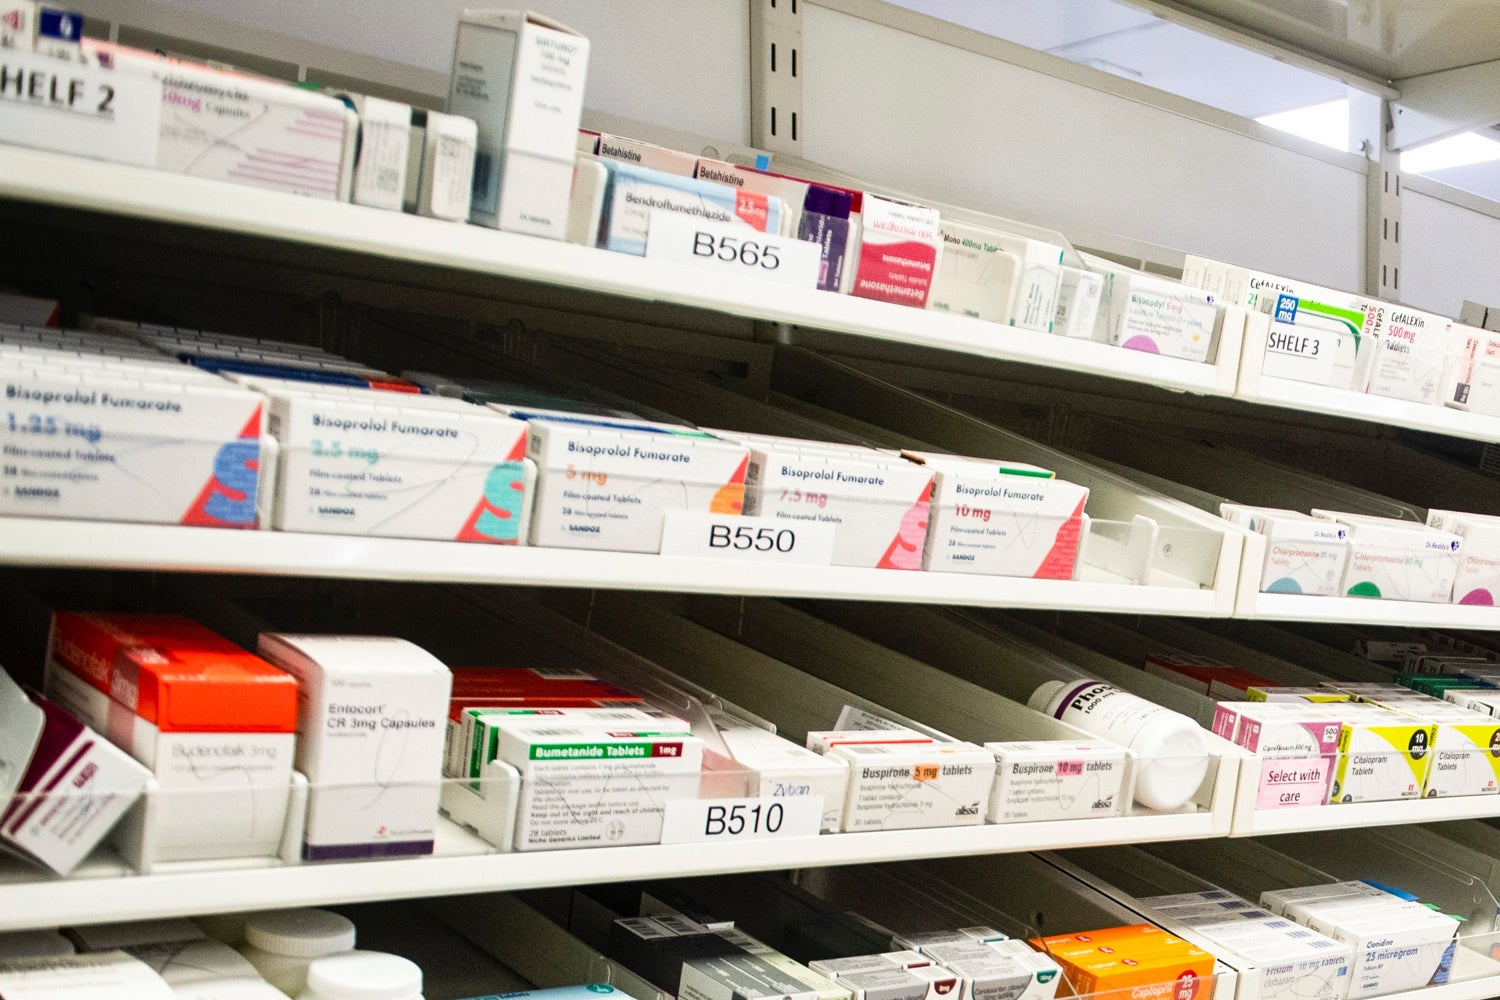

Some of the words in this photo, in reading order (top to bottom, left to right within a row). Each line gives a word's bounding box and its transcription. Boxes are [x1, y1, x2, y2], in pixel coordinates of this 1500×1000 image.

[98, 84, 115, 113] 2
[601, 143, 642, 163] Betahistine
[700, 166, 745, 188] Betahistine
[625, 191, 732, 223] Bendroflumethiazide
[692, 230, 781, 270] B565
[860, 277, 925, 300] Betamethasone
[1131, 293, 1165, 310] Bisacodyl
[1279, 296, 1296, 311] 250
[1391, 310, 1425, 329] CefALEXin
[1268, 332, 1310, 353] SHELF
[1312, 340, 1320, 356] 3
[5, 383, 97, 407] Bisoprolol
[101, 392, 182, 414] Fumarate
[311, 413, 388, 434] Bisoprolol
[391, 422, 459, 440] Fumarate
[567, 440, 632, 460] Bisoprolol
[633, 446, 691, 465] Fumarate
[781, 465, 835, 483] Bisoprolol
[836, 470, 885, 487] Fumarate
[779, 487, 800, 503] 7.5
[805, 490, 829, 508] mg
[955, 482, 1001, 498] Bisoprolol
[1002, 487, 1045, 502] Fumarate
[971, 504, 992, 522] mg
[708, 523, 796, 554] B550
[327, 701, 383, 716] Entocort
[327, 717, 346, 730] CR
[350, 717, 377, 732] 3mg
[380, 716, 436, 731] Capsules
[1414, 732, 1425, 743] 10
[172, 741, 246, 760] Budenofalk
[250, 744, 277, 760] 3mg
[535, 745, 604, 760] Bumetanide
[606, 743, 645, 759] Tablets
[658, 743, 678, 758] 1mg
[1439, 751, 1471, 764] Citalopram
[1012, 762, 1054, 776] Buspirone
[1086, 759, 1113, 773] tablets
[1353, 755, 1388, 767] Citalopram
[1436, 761, 1458, 772] Tablets
[862, 765, 911, 781] Buspirone
[914, 766, 923, 779] 5
[924, 766, 939, 781] mg
[942, 763, 974, 777] tablets
[1267, 769, 1298, 785] Select
[1299, 769, 1321, 783] with
[1351, 766, 1374, 777] Tablets
[773, 783, 811, 799] Zyban
[1279, 791, 1301, 804] care
[705, 802, 785, 837] B510
[1366, 939, 1394, 950] Clonidine
[1366, 952, 1376, 963] 25
[1377, 947, 1418, 962] microgram
[1131, 983, 1173, 1000] Captopril
[1181, 976, 1195, 990] 25
